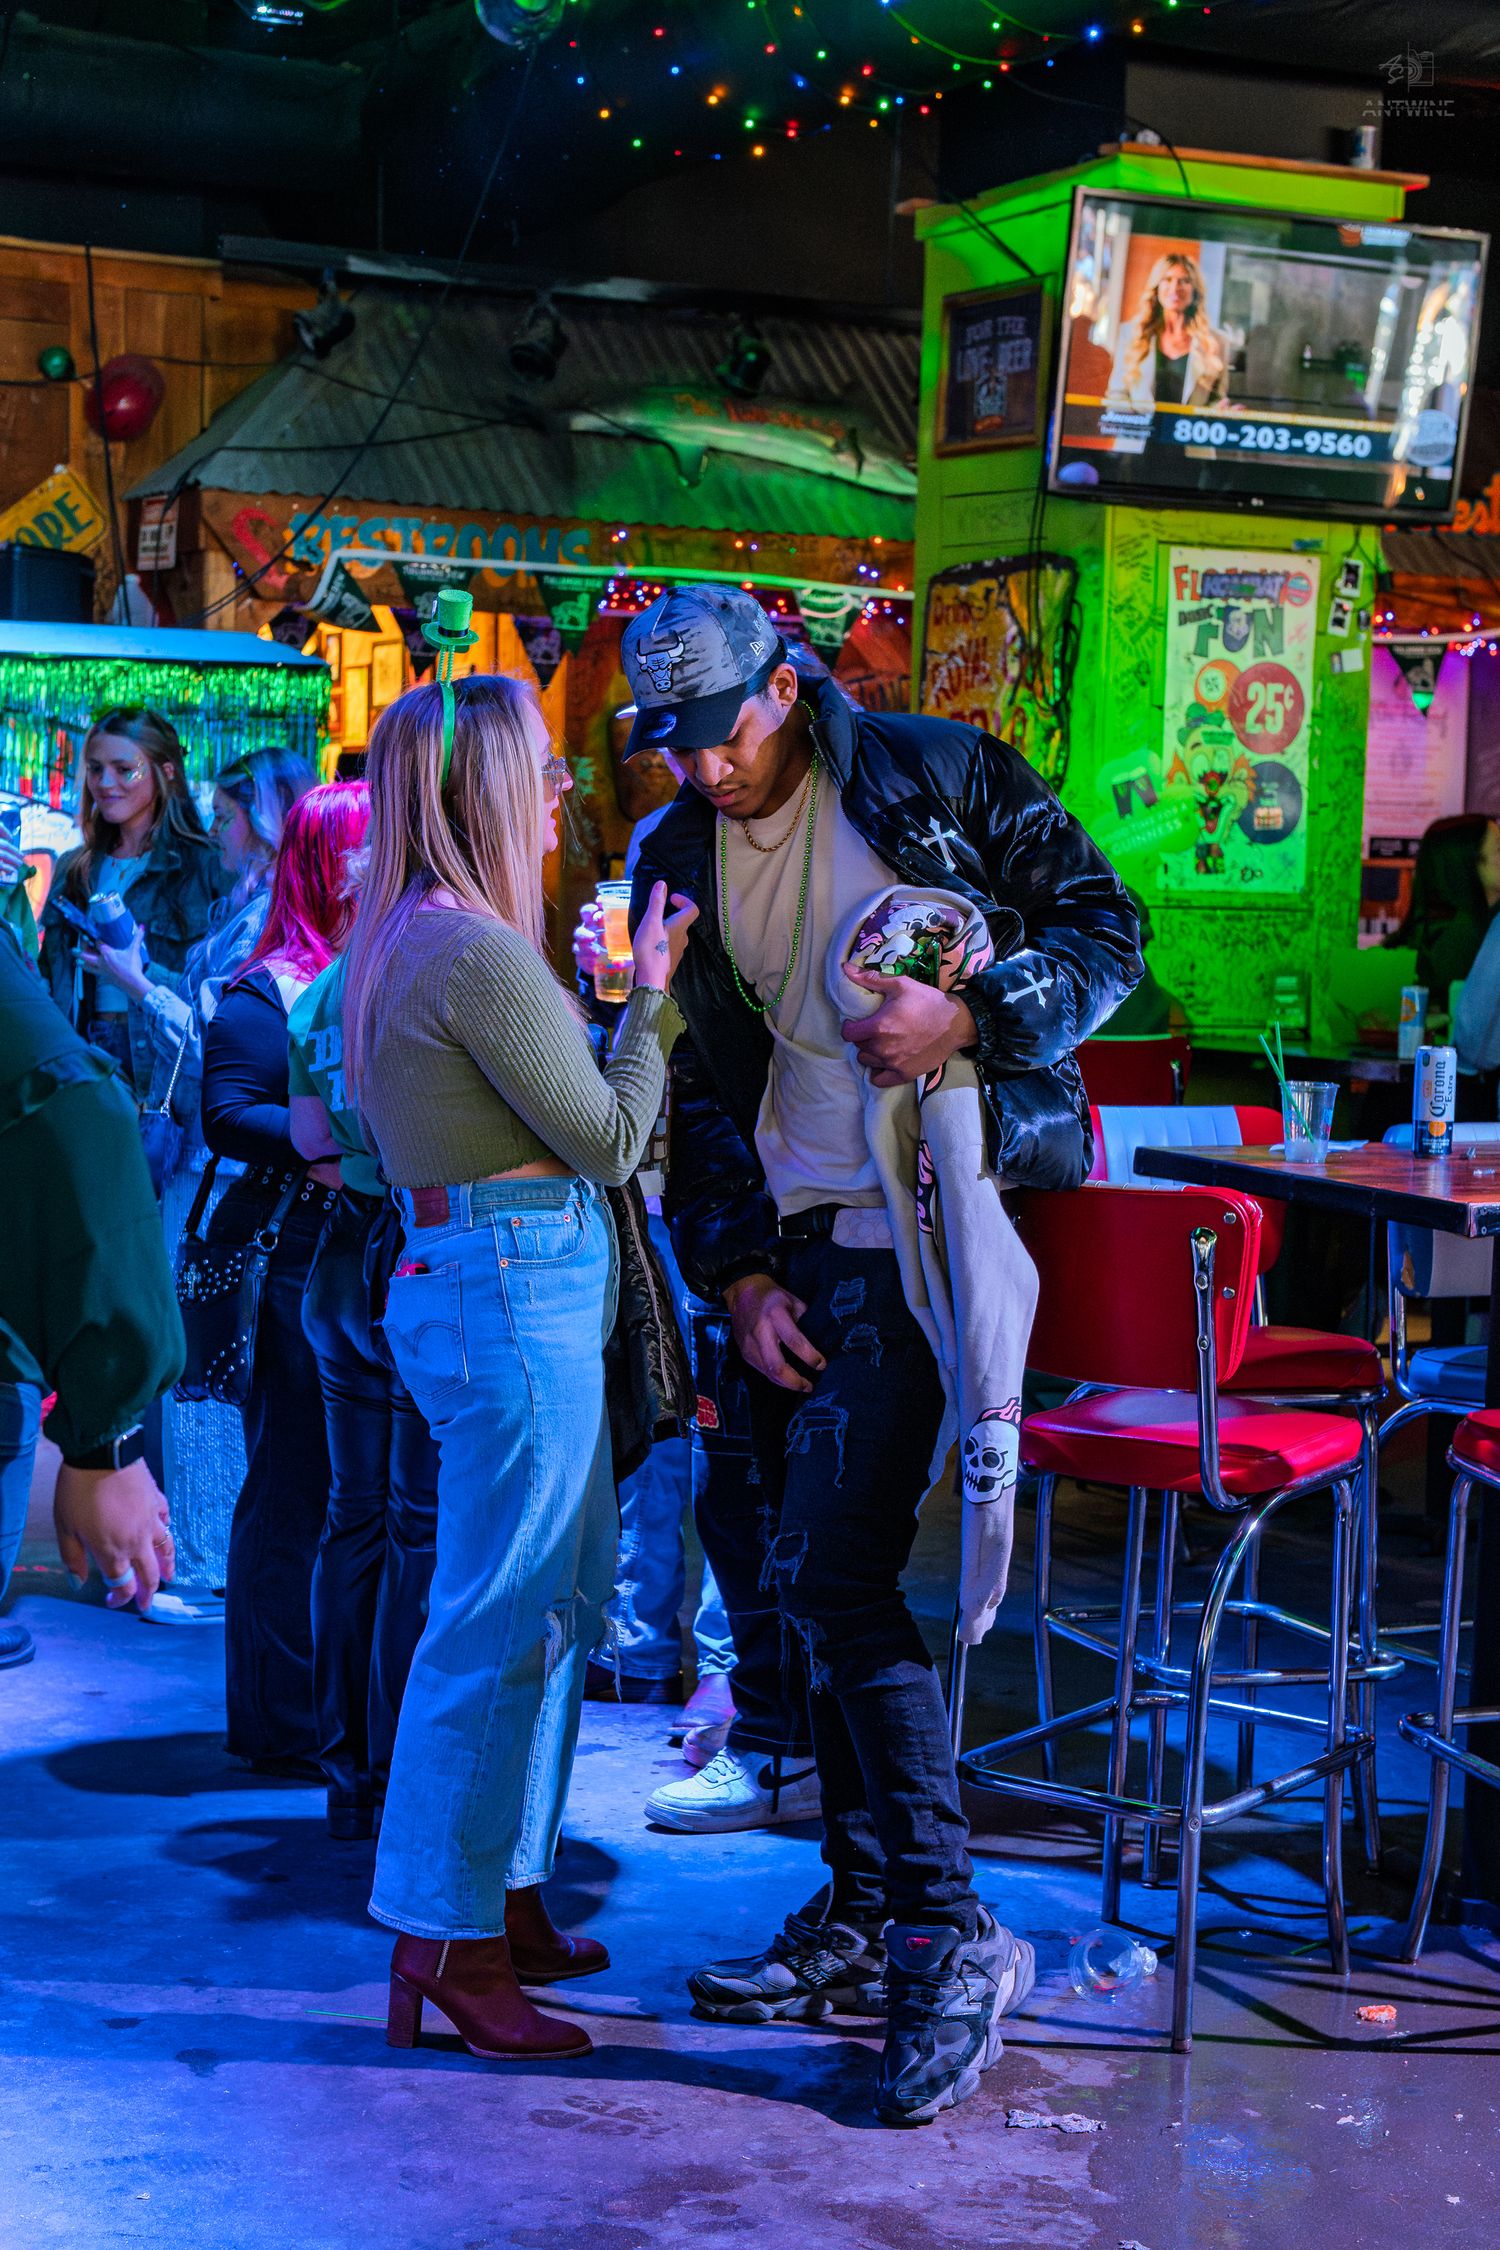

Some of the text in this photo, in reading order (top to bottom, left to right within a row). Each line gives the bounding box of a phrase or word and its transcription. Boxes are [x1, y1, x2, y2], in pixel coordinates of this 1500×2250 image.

[1174, 419, 1372, 458] 800-203-9560
[285, 513, 592, 582] RESTROOMS
[1111, 818, 1183, 857] GUINNESS
[1429, 1061, 1446, 1118] Corona
[1445, 1075, 1454, 1103] Extra
